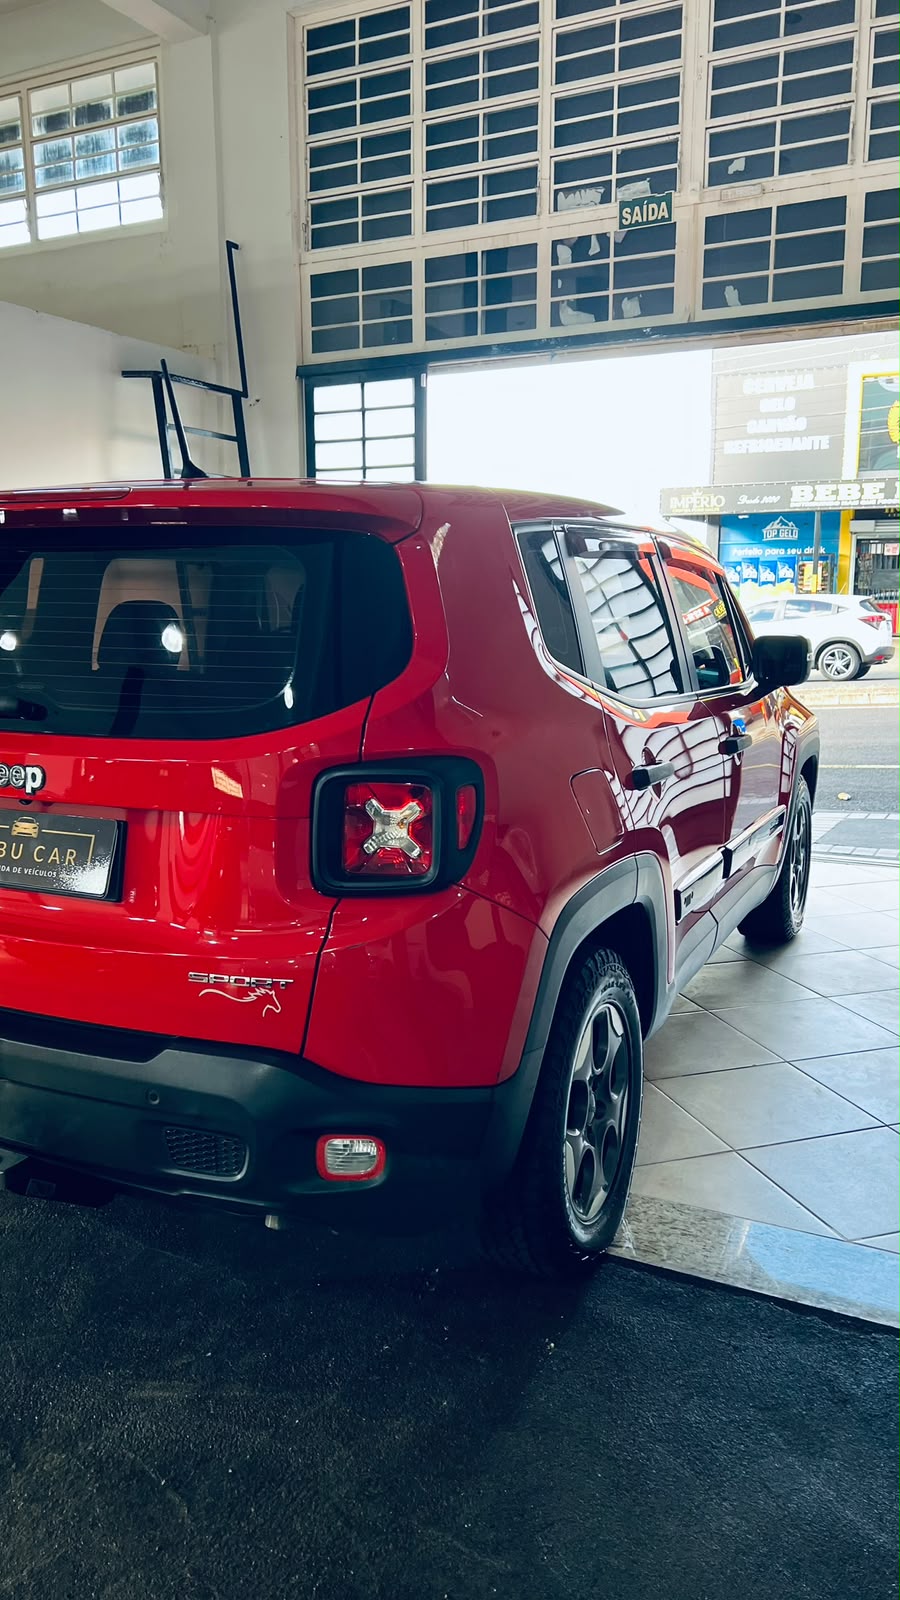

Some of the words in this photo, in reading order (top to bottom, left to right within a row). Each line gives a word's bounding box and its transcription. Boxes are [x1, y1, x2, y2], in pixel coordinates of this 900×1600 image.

[622, 200, 669, 225] SAÍDA
[790, 482, 885, 502] BEBE
[763, 529, 778, 539] TOP
[780, 528, 799, 538] GELO
[765, 548, 785, 557] para
[787, 547, 802, 555] seu
[804, 545, 826, 554] drik
[33, 845, 77, 865] CAR
[0, 864, 10, 872] DA
[12, 866, 22, 874] DE
[24, 866, 57, 878] VEÍCULOS
[188, 971, 294, 989] SPORT
